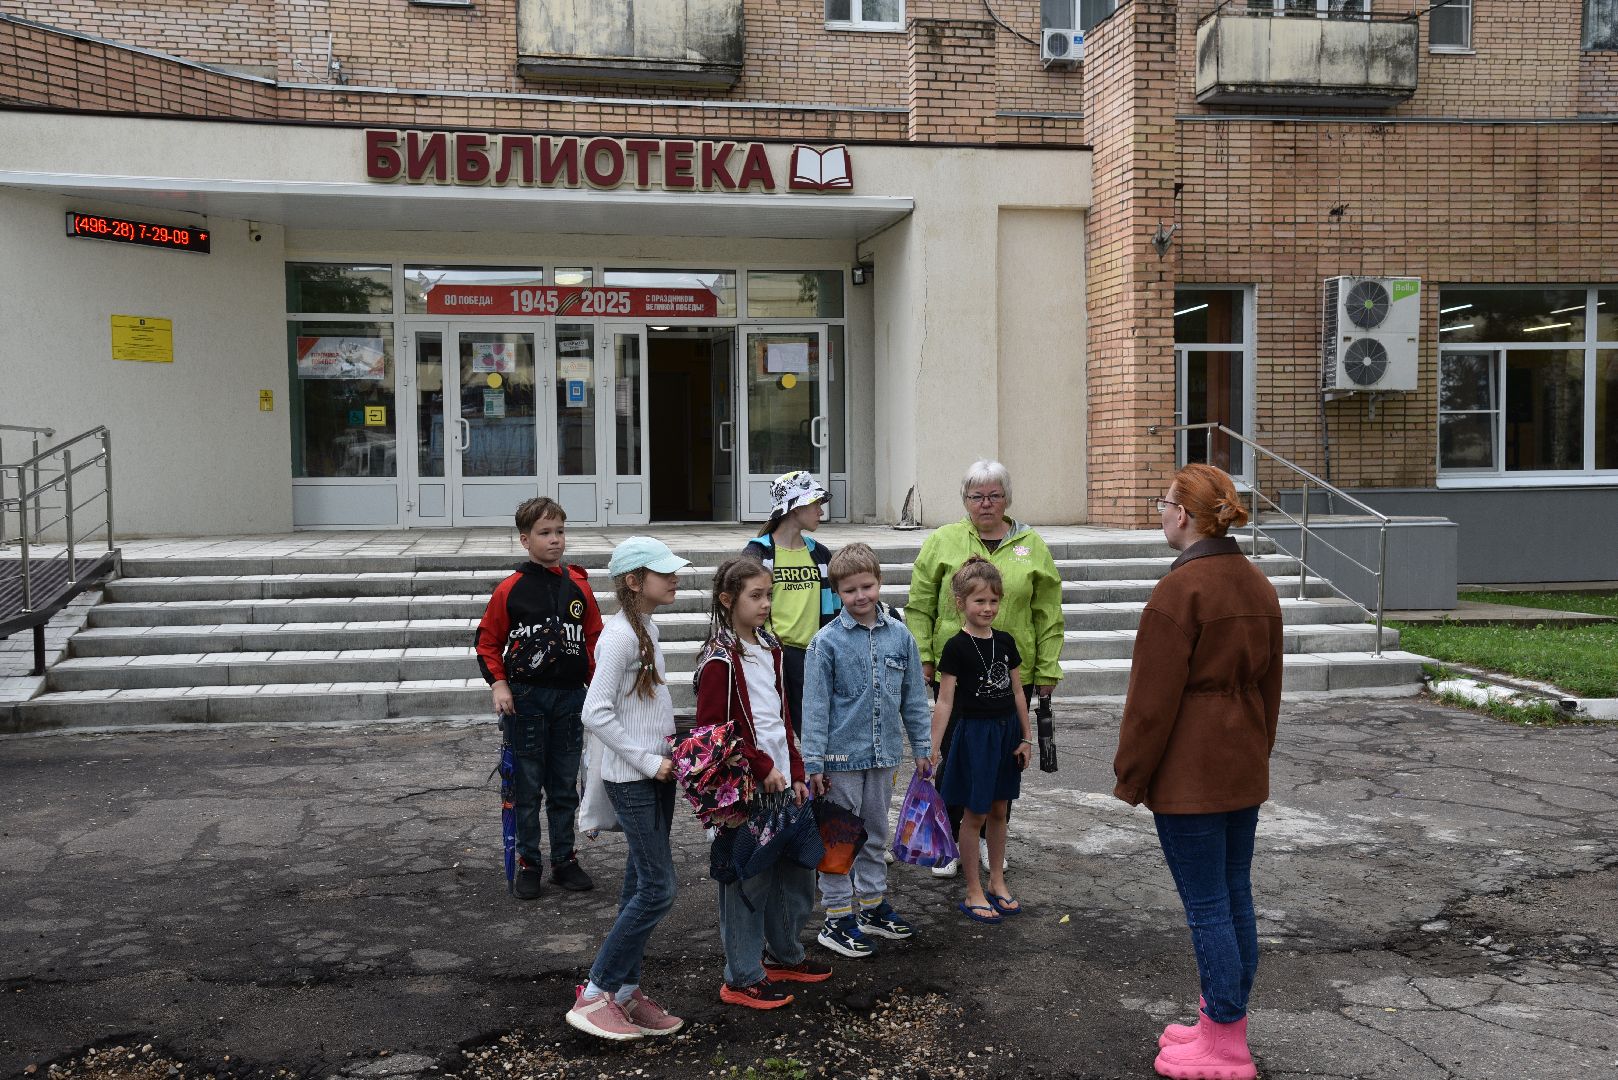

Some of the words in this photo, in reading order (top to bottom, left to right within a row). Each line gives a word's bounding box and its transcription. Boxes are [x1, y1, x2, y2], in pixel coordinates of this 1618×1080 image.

[365, 130, 776, 190] БИБЛИОТЕКА
[75, 215, 135, 240] (496-28)
[139, 224, 189, 245] 7-29-09
[444, 294, 457, 306] 80
[458, 295, 493, 306] ПОБЕДА!
[510, 289, 559, 313] 1945
[580, 290, 631, 314] 2025
[651, 295, 694, 303] ПРАЗДНИКОМ
[645, 303, 675, 311] ВЕЛИКОЙ
[773, 567, 820, 581] ERROR
